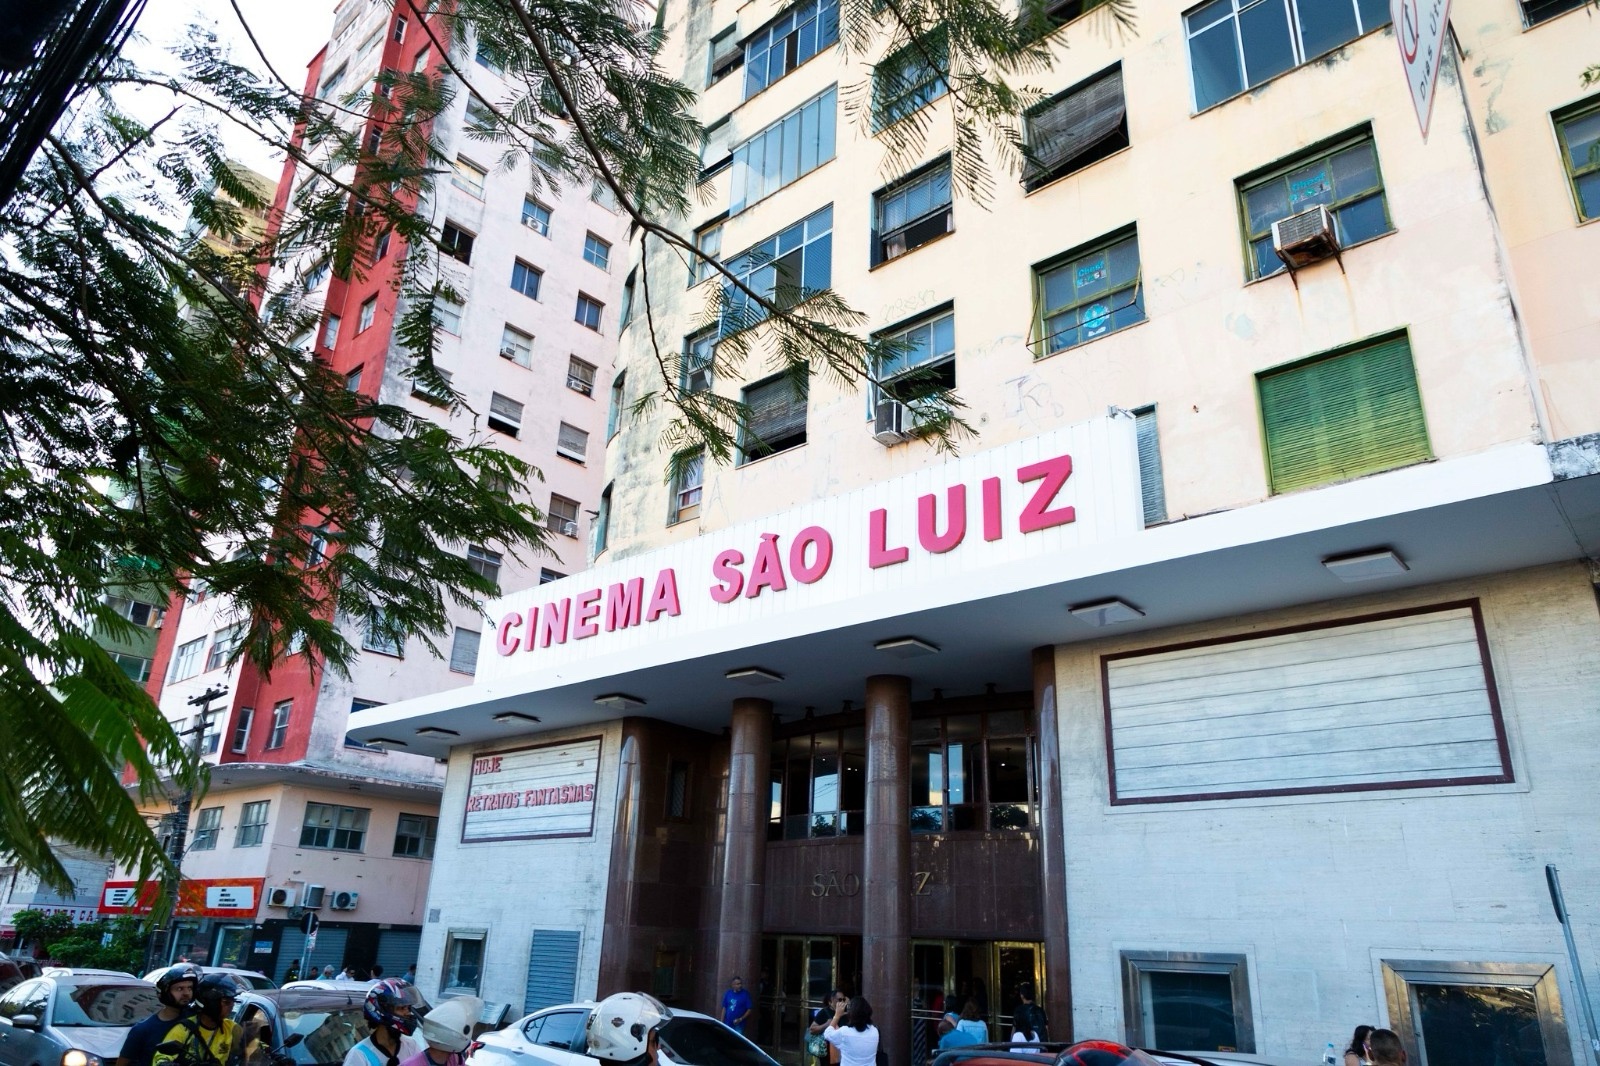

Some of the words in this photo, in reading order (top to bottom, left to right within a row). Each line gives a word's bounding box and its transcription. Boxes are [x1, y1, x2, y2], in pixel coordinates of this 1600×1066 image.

[496, 568, 681, 657] CINEMA
[709, 526, 833, 604] SÃO
[869, 454, 1076, 569] LUIZ
[473, 756, 503, 775] HOJE
[467, 791, 520, 812] RETRATOS
[524, 783, 595, 807] FANTASMAS
[811, 869, 860, 897] SÃO
